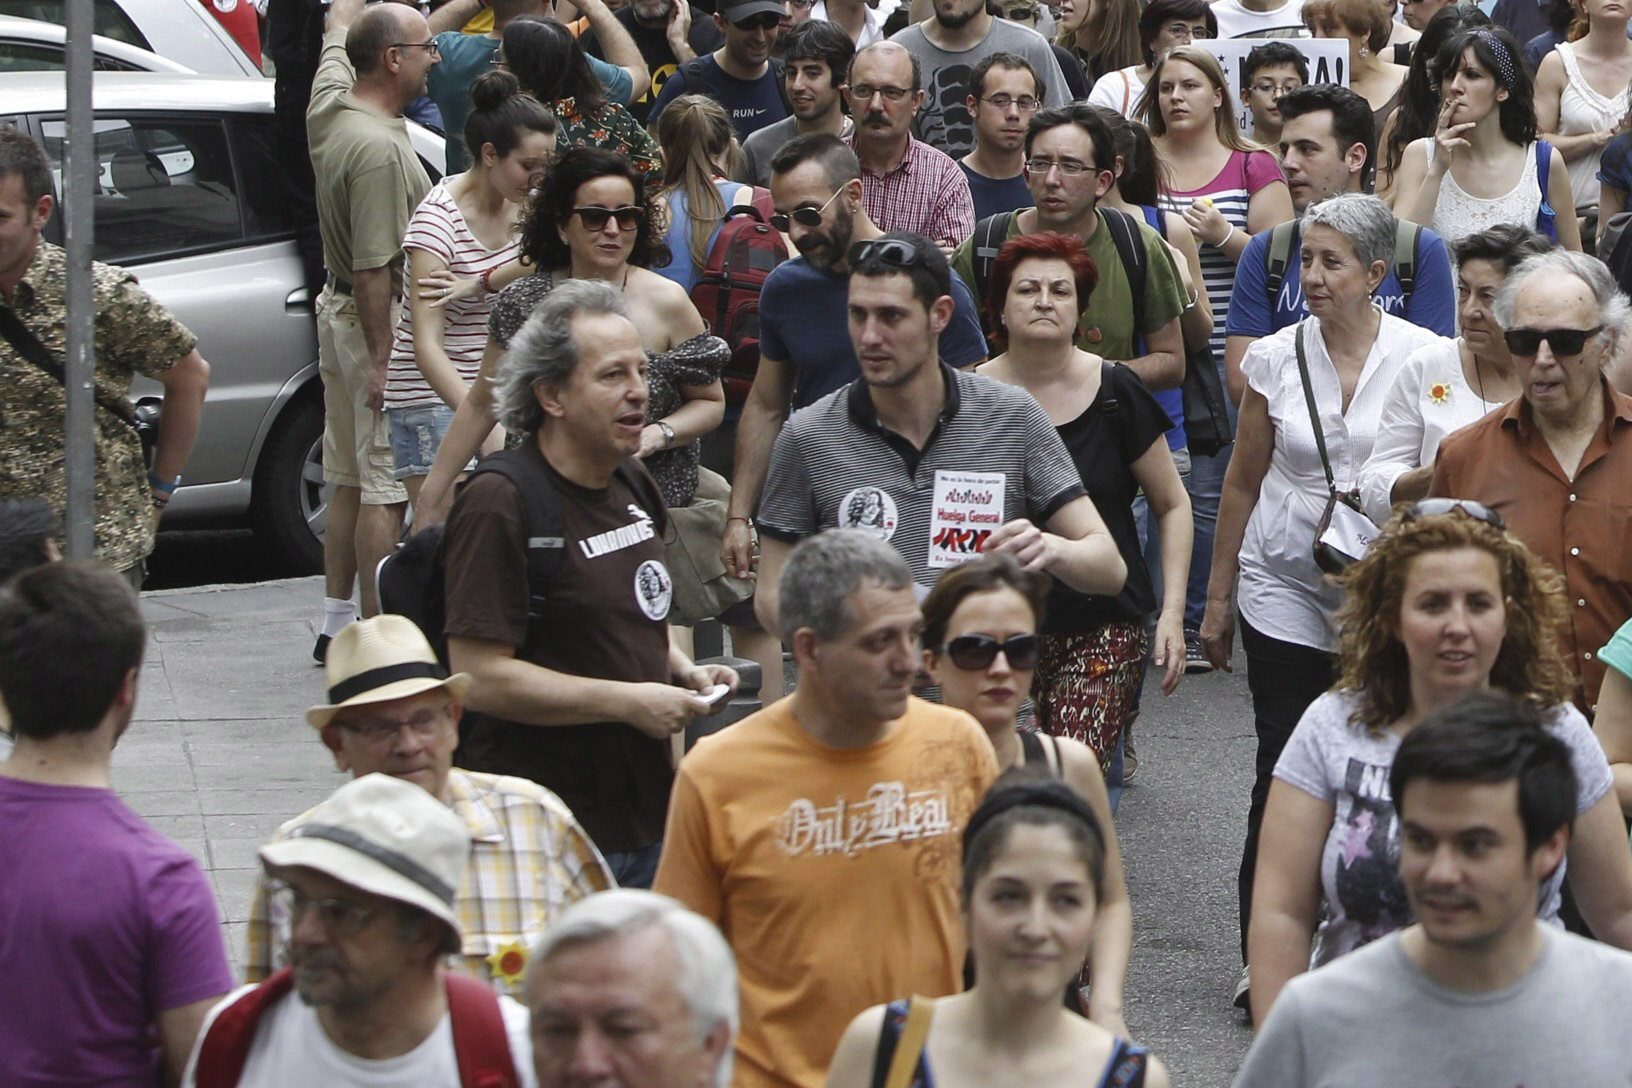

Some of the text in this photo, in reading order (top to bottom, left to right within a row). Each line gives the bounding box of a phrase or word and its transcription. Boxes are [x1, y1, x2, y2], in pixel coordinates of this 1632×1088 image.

[733, 108, 755, 118] RUN
[937, 508, 1000, 524] Huelga General
[776, 795, 866, 857] Only
